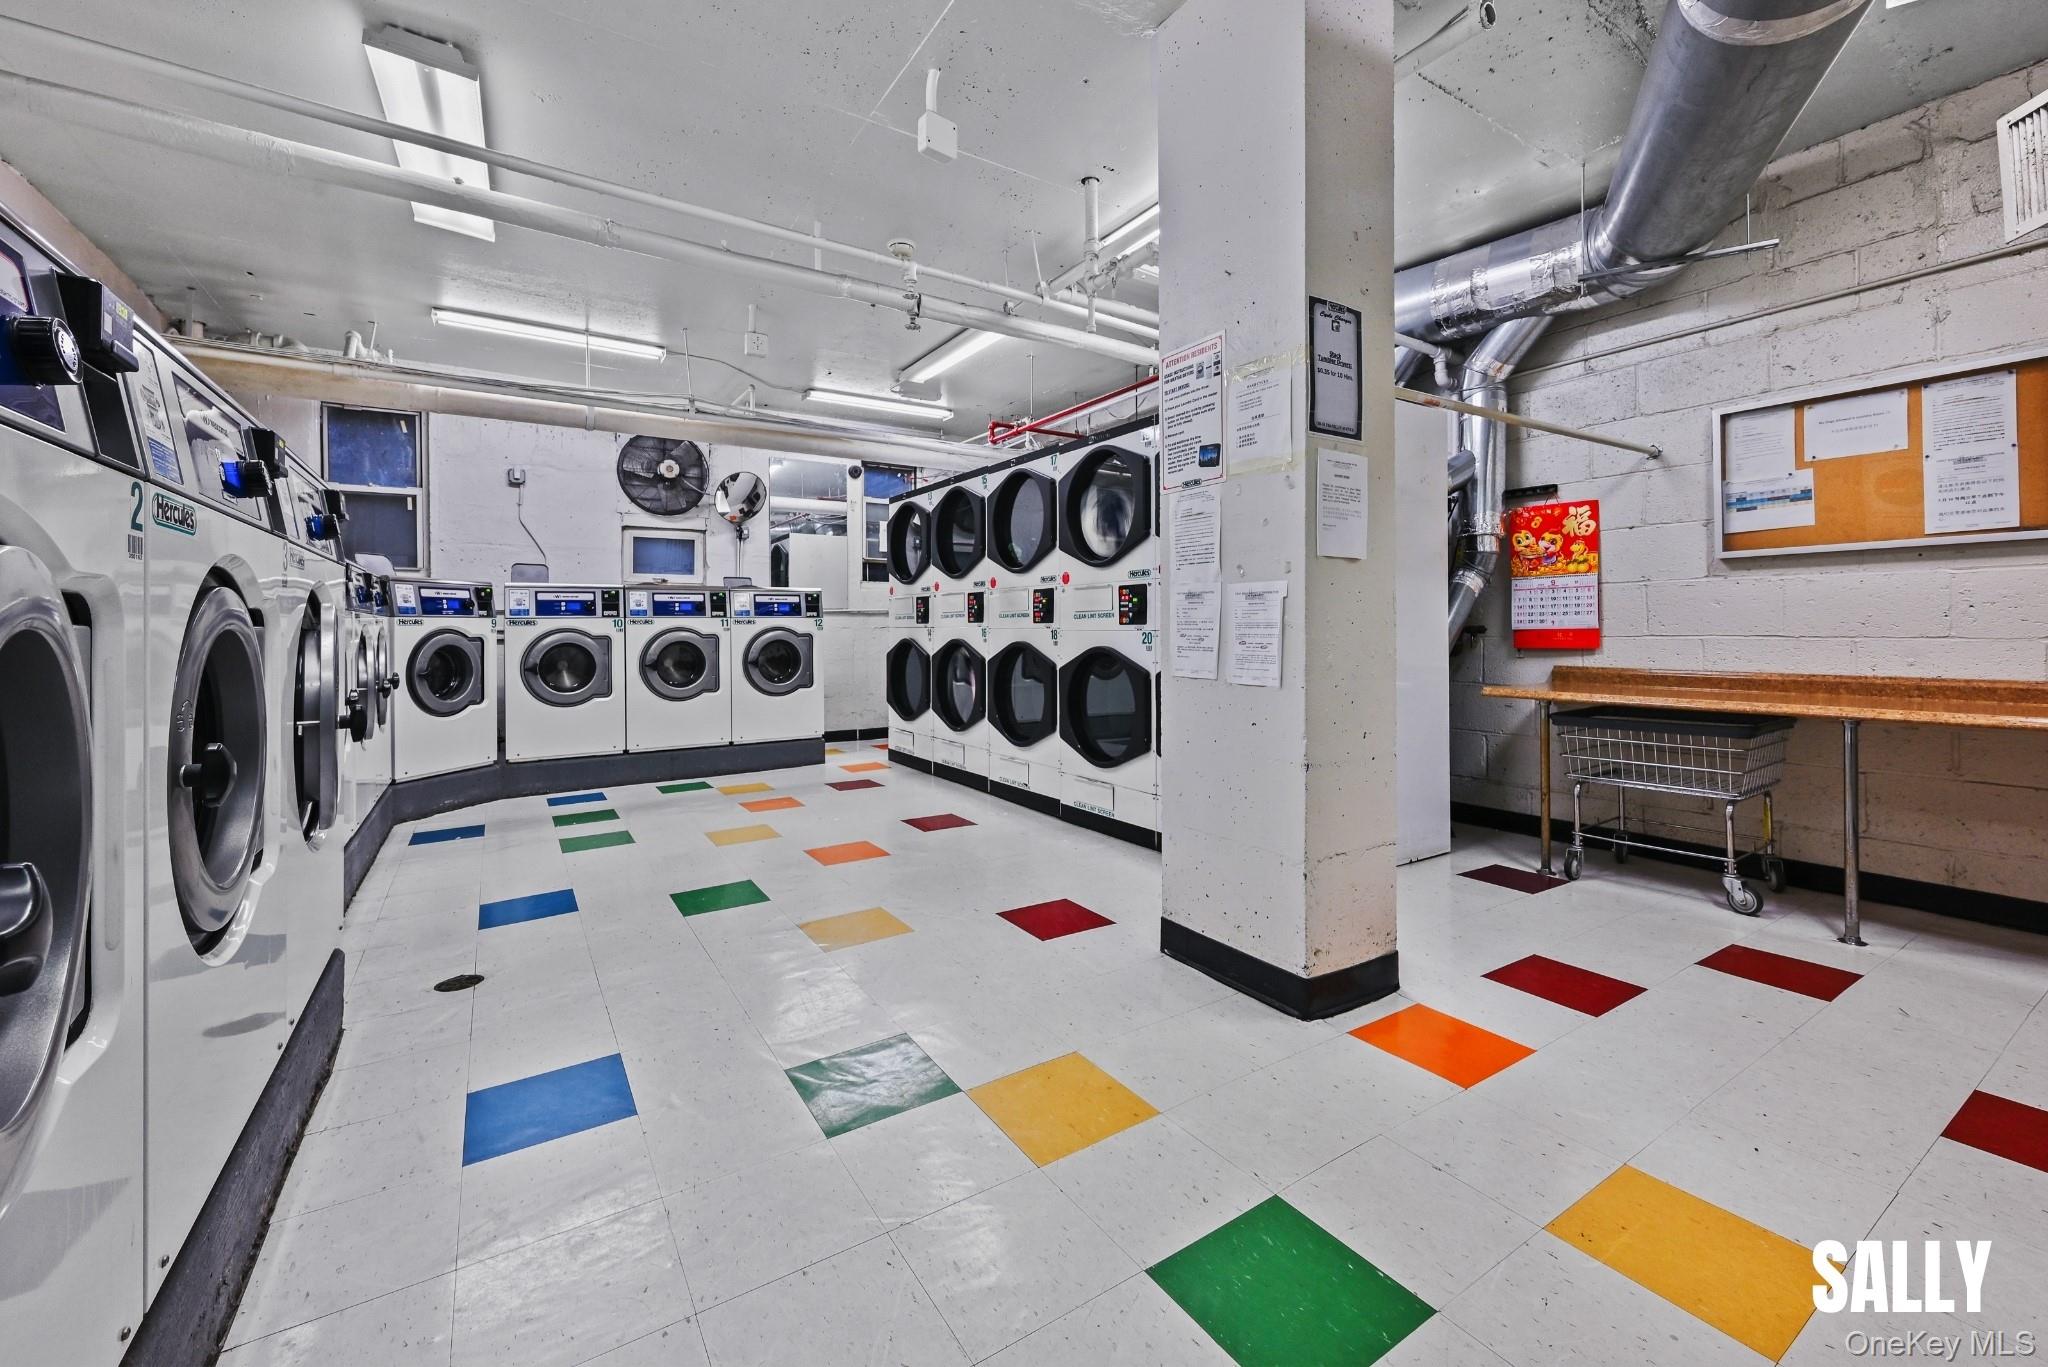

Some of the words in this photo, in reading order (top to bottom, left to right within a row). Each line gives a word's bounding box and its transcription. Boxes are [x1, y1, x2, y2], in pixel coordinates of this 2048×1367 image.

[1166, 353, 1190, 369] ATTENTION
[1191, 342, 1218, 358] RESIDENTS
[1051, 454, 1057, 465] 17
[131, 482, 143, 532] 2
[157, 494, 194, 529] Hercules
[1562, 505, 1596, 537] 福
[1129, 569, 1150, 577] Hercules
[491, 619, 496, 628] 9
[612, 619, 623, 628] 10
[720, 619, 729, 627] 11
[814, 619, 823, 627] 12
[982, 628, 987, 637] 16
[1051, 629, 1057, 640] 18
[1142, 632, 1152, 644] 20
[1074, 801, 1086, 809] CLEAN
[1098, 808, 1114, 817] SCREEN
